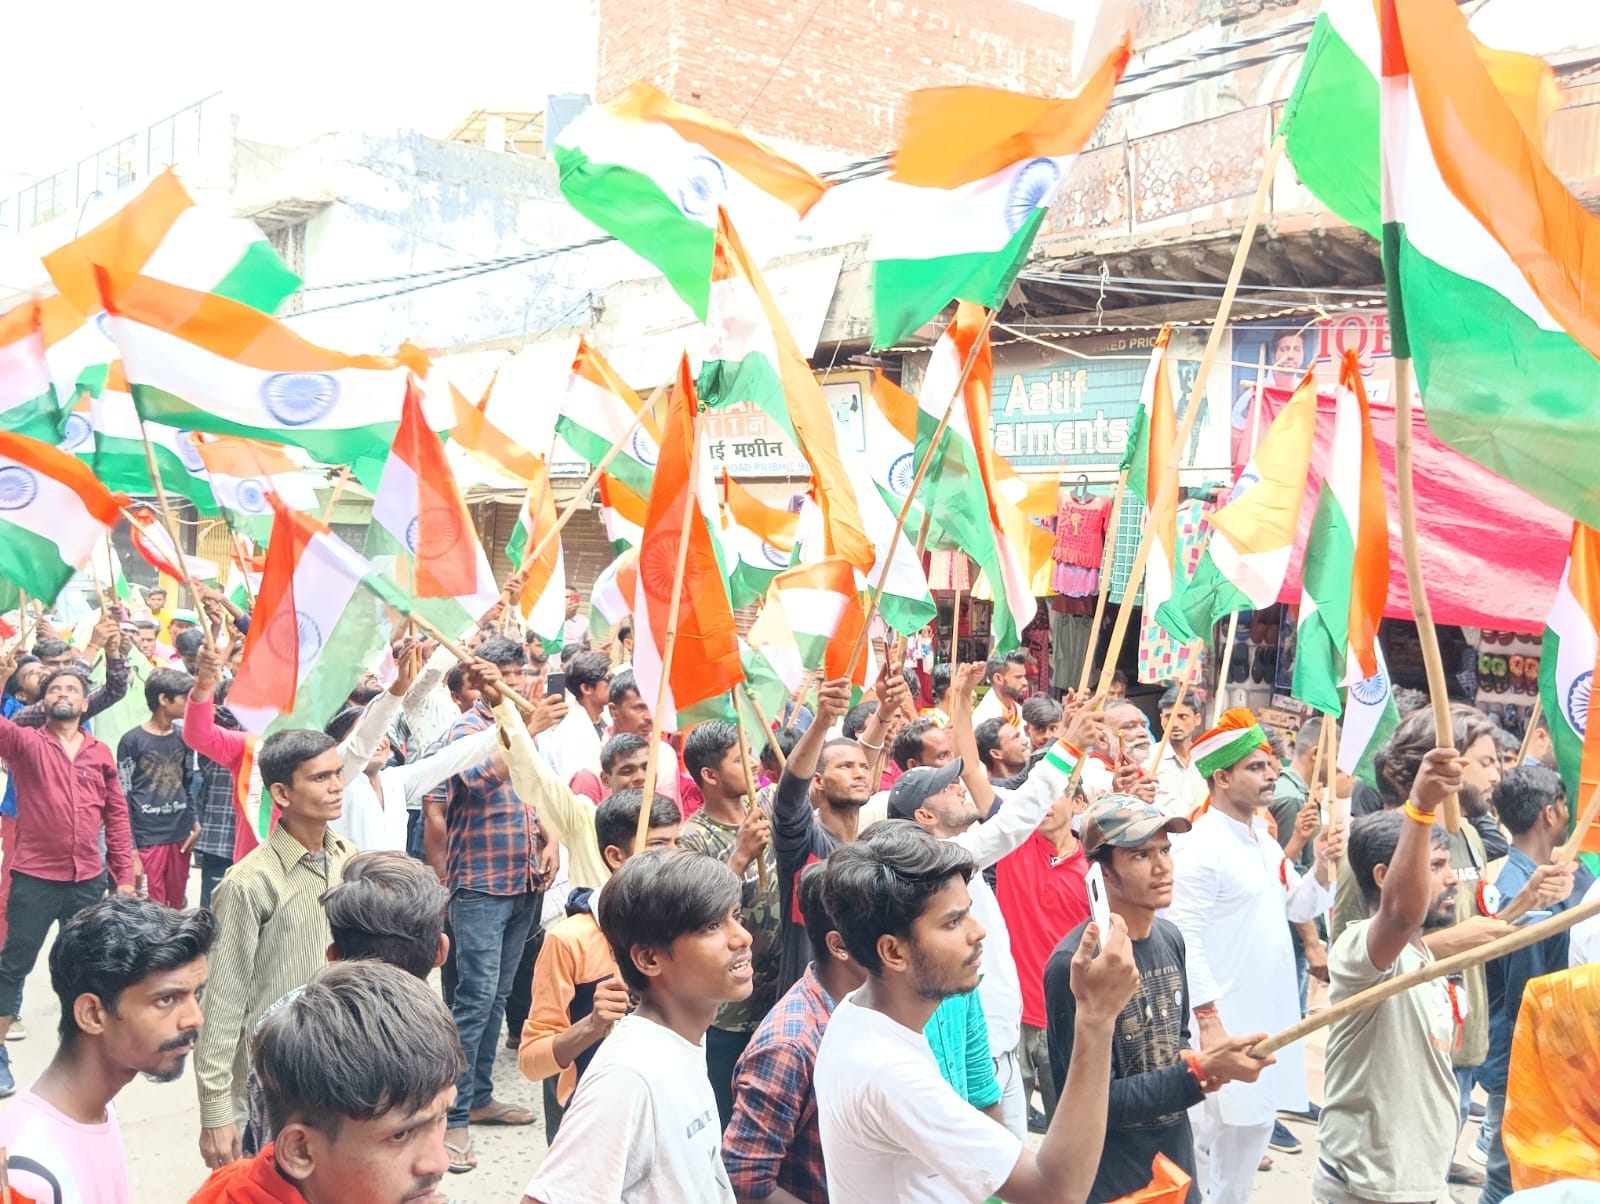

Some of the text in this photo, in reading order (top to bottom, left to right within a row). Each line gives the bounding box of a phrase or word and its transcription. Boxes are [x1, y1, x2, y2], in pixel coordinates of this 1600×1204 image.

[1129, 336, 1156, 349] PRIC
[1003, 369, 1088, 416] Aatif
[989, 409, 1129, 456] arments
[732, 438, 784, 458] मशीन
[727, 462, 752, 473] OAD
